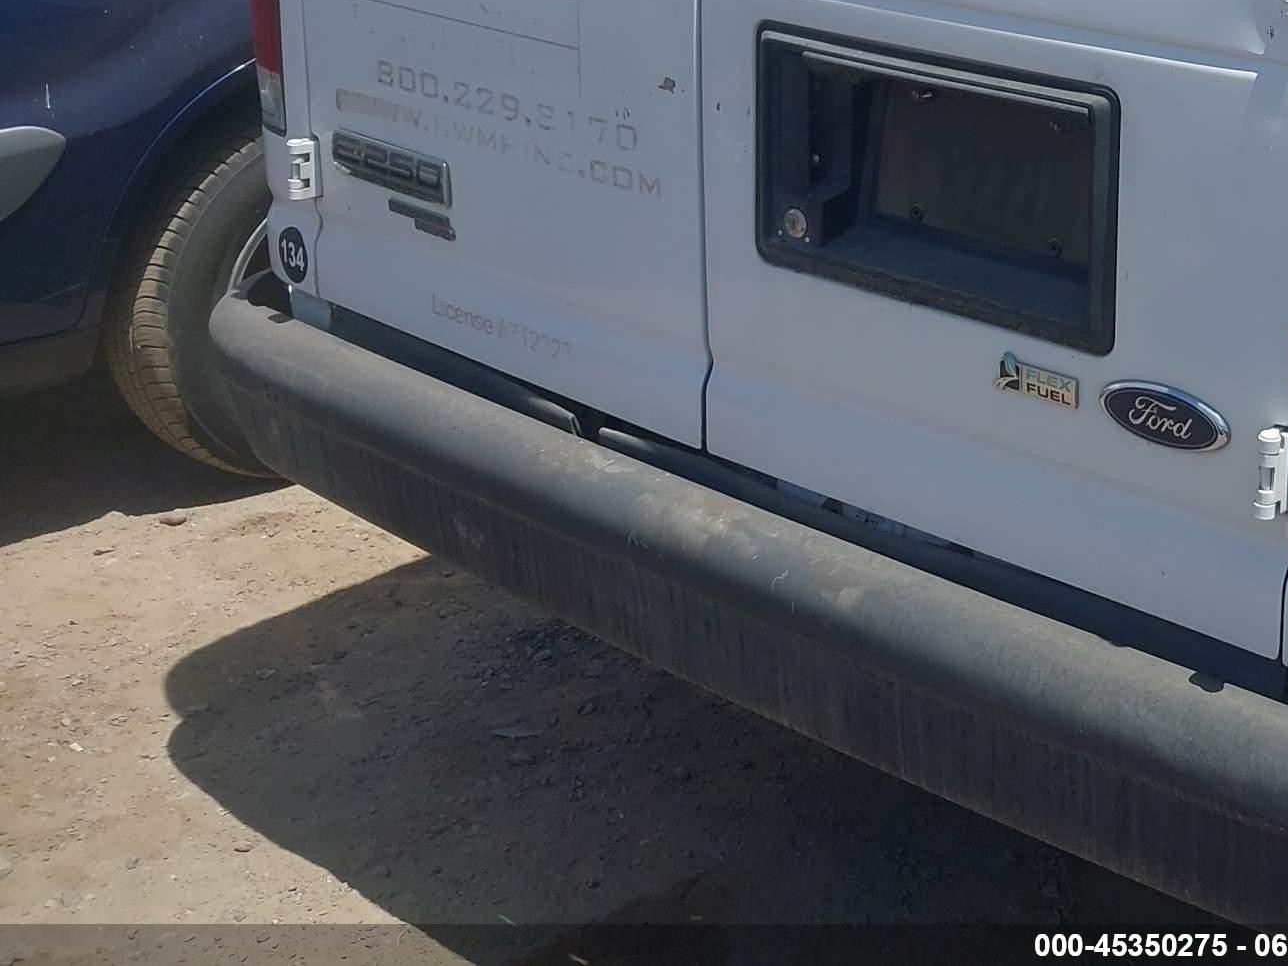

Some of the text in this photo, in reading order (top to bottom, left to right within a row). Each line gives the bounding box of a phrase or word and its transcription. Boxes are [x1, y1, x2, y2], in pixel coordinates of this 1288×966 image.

[281, 238, 305, 272] 134
[1025, 367, 1073, 392] FLEX
[1026, 382, 1072, 406] FUEL
[1128, 395, 1193, 440] Ford
